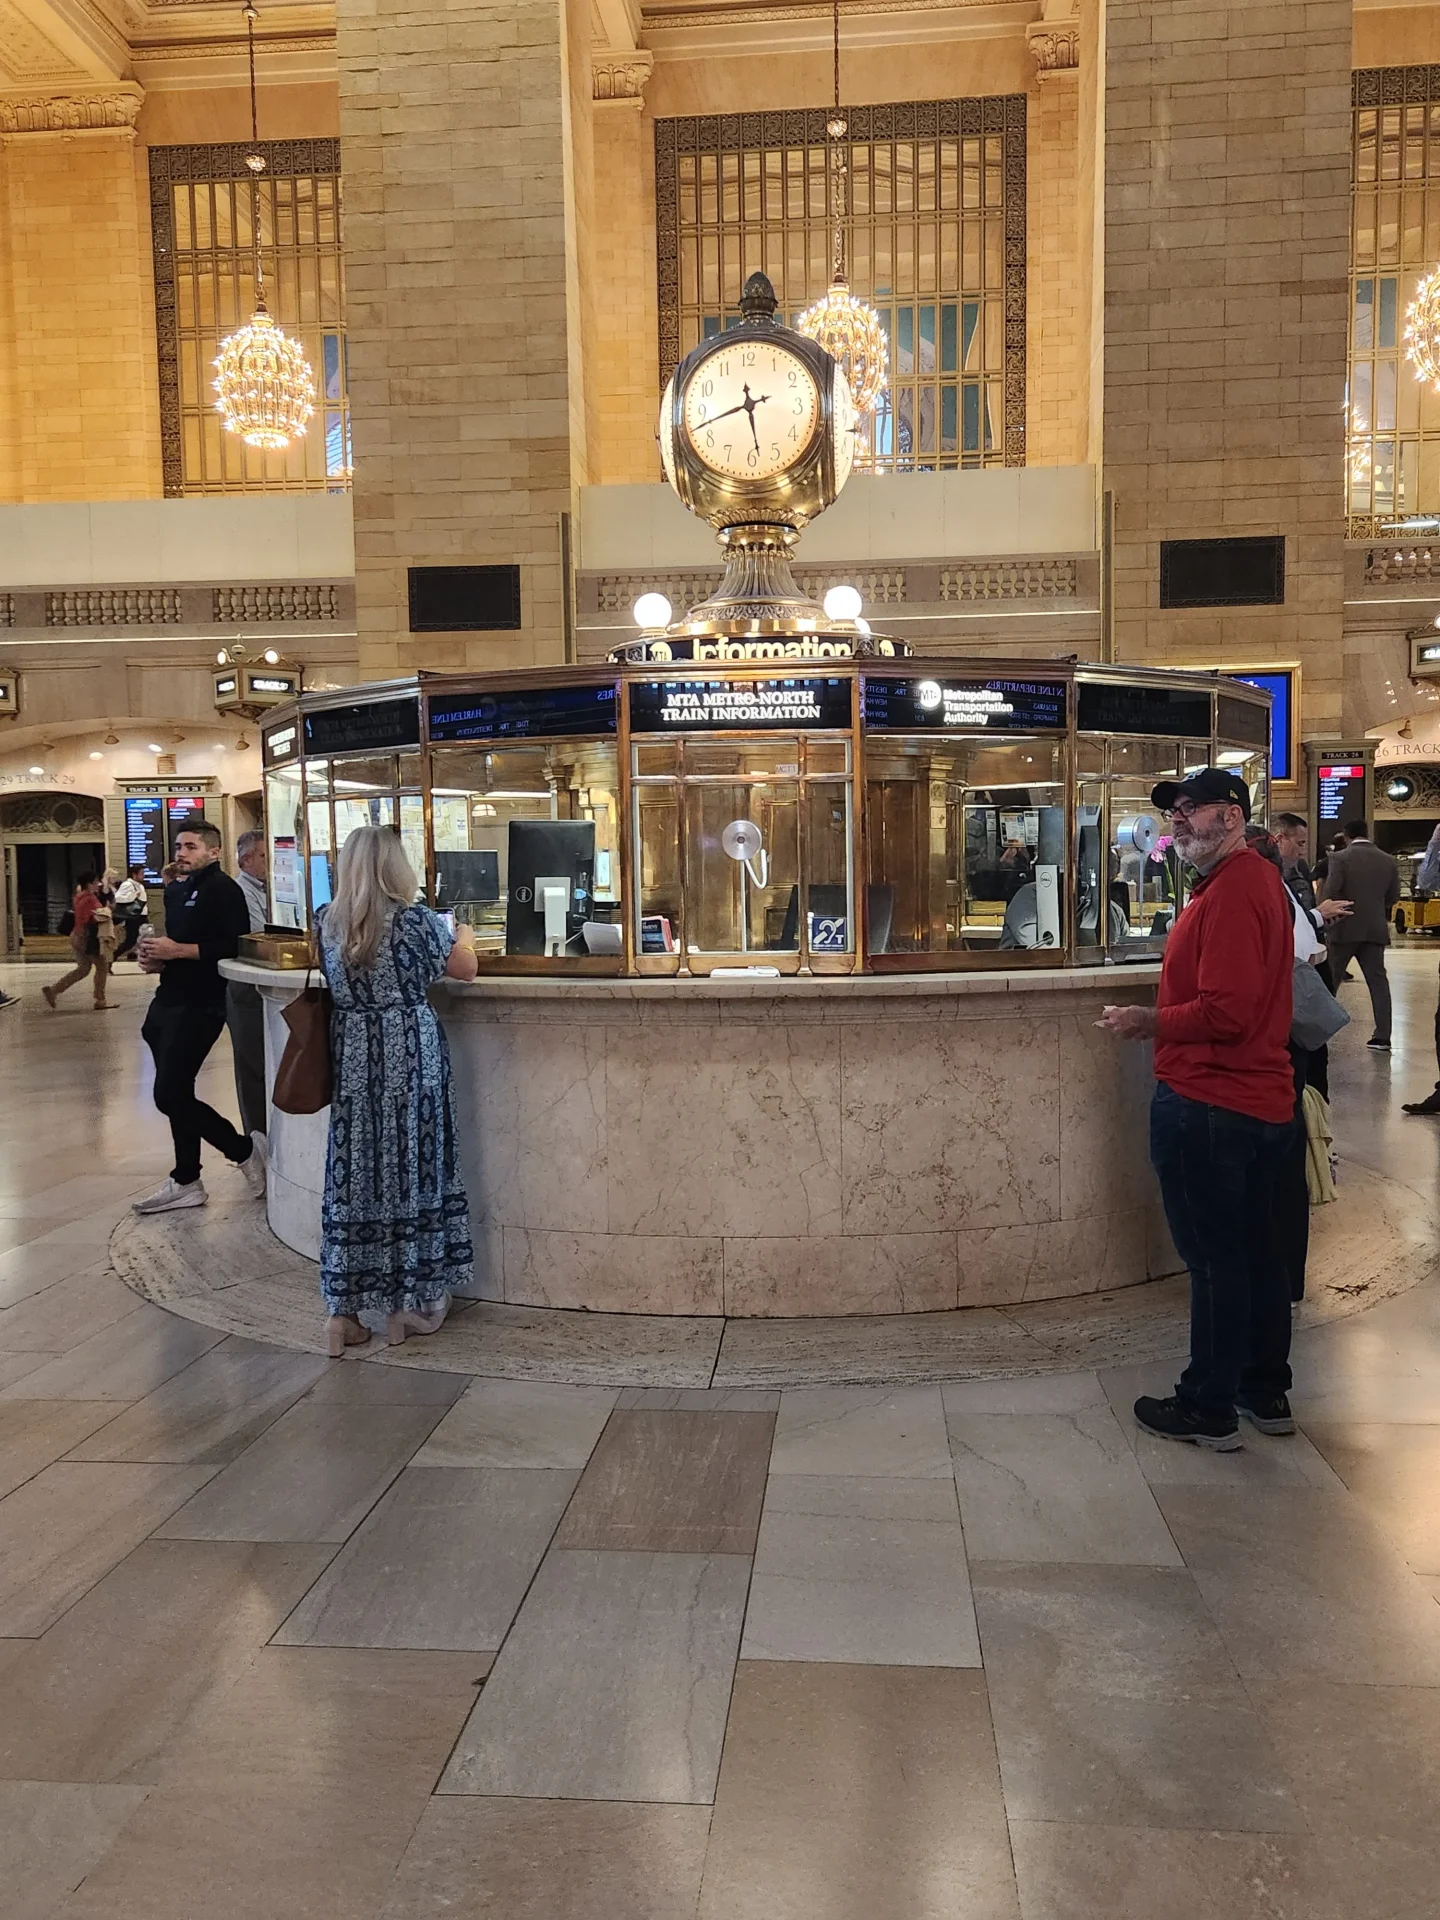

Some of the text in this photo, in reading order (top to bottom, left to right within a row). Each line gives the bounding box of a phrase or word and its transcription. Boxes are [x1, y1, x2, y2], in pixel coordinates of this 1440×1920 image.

[742, 352, 756, 367] 12
[719, 362, 729, 377] 11
[701, 379, 714, 397] 10
[788, 372, 797, 388] 2
[698, 404, 707, 422] 9
[793, 397, 803, 415] 3
[706, 430, 715, 447] 8
[788, 424, 799, 441] 4
[723, 445, 733, 462] 7
[747, 449, 757, 467] 6
[770, 443, 781, 461] 5
[667, 690, 815, 706] MTA METRO-NORTH
[943, 689, 1004, 703] Metropolitan
[660, 705, 821, 721] TRAIN INFORMATION
[943, 701, 1014, 713] Transportation
[943, 712, 989, 725] Authority
[1393, 742, 1440, 756] TRACK
[1, 773, 75, 786] 29 TRACK 29
